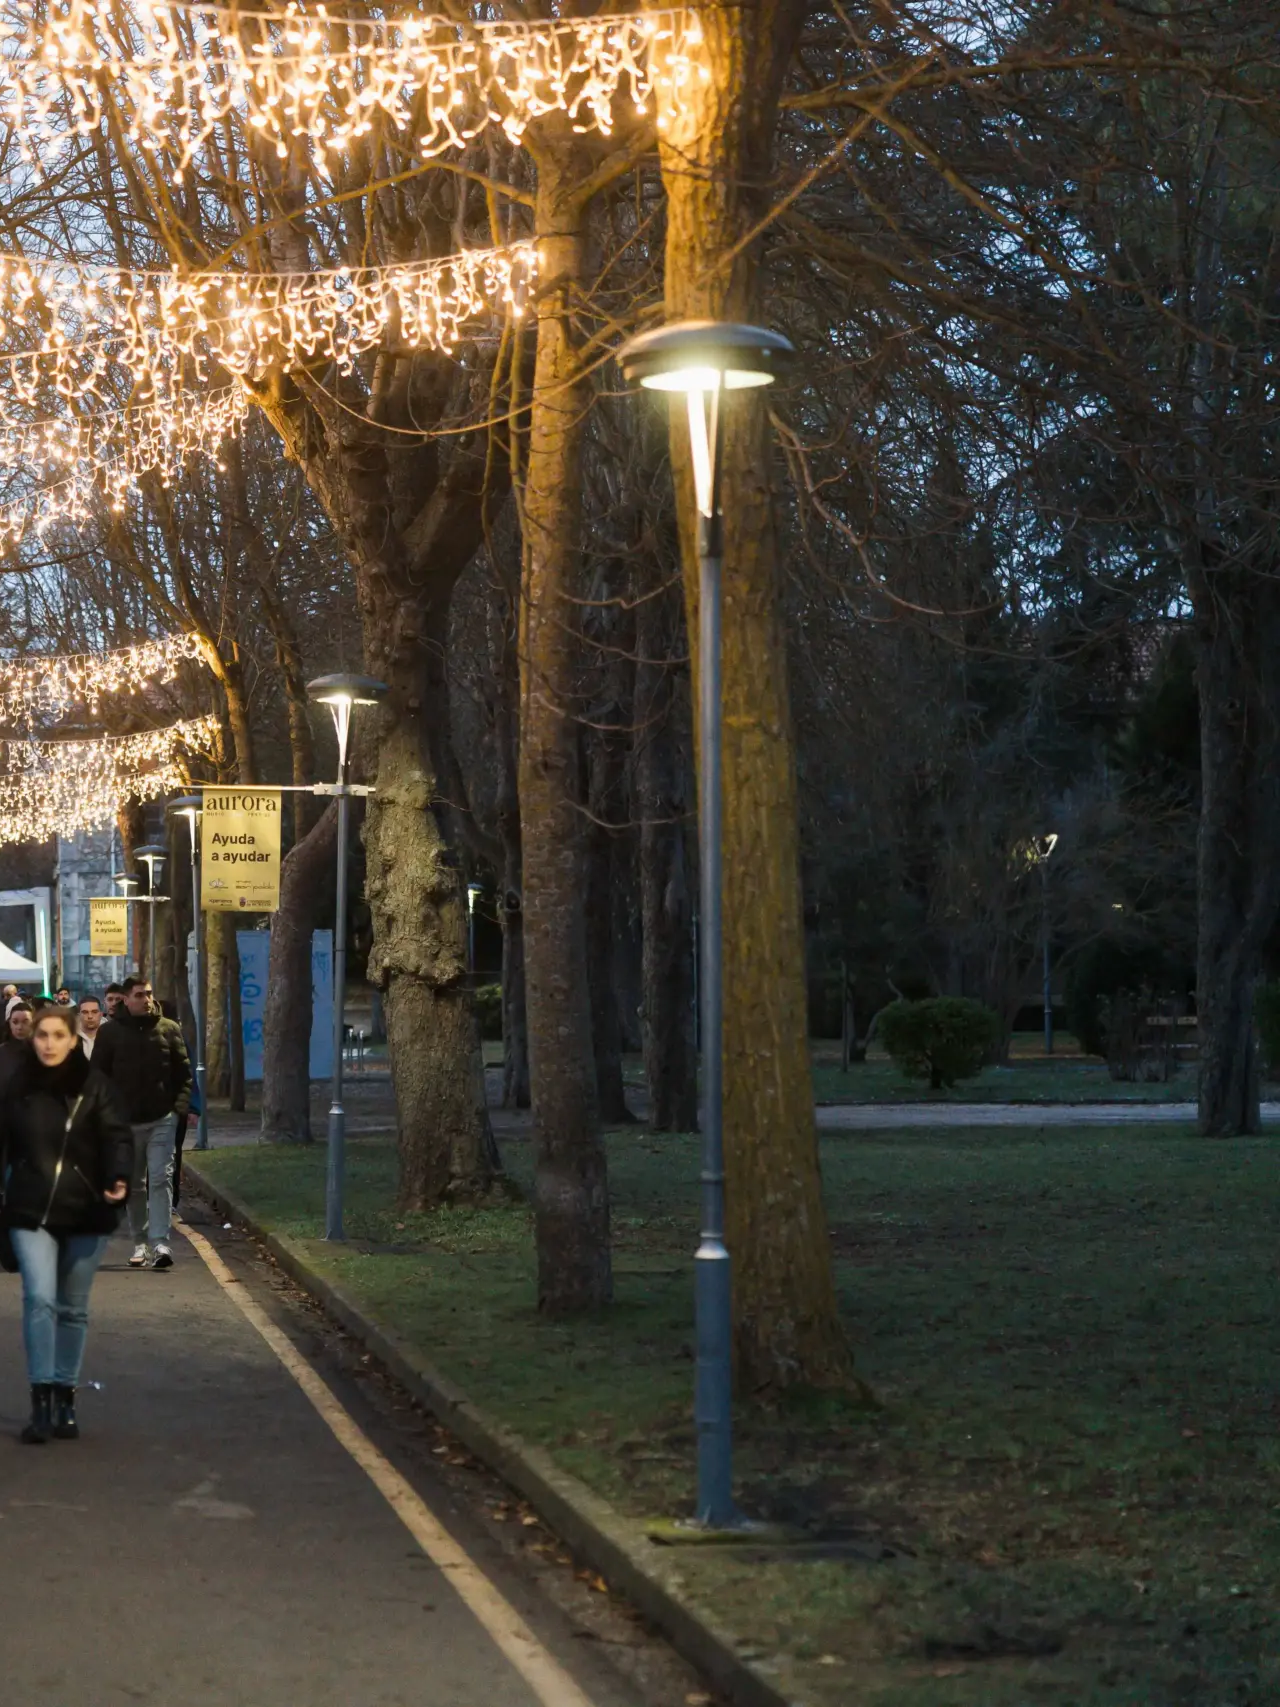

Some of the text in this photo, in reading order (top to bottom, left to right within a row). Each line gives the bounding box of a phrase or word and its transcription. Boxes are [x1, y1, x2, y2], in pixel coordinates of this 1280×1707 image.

[206, 795, 277, 812] aurora
[211, 833, 255, 846] Ayuda
[211, 851, 271, 864] a ayudar
